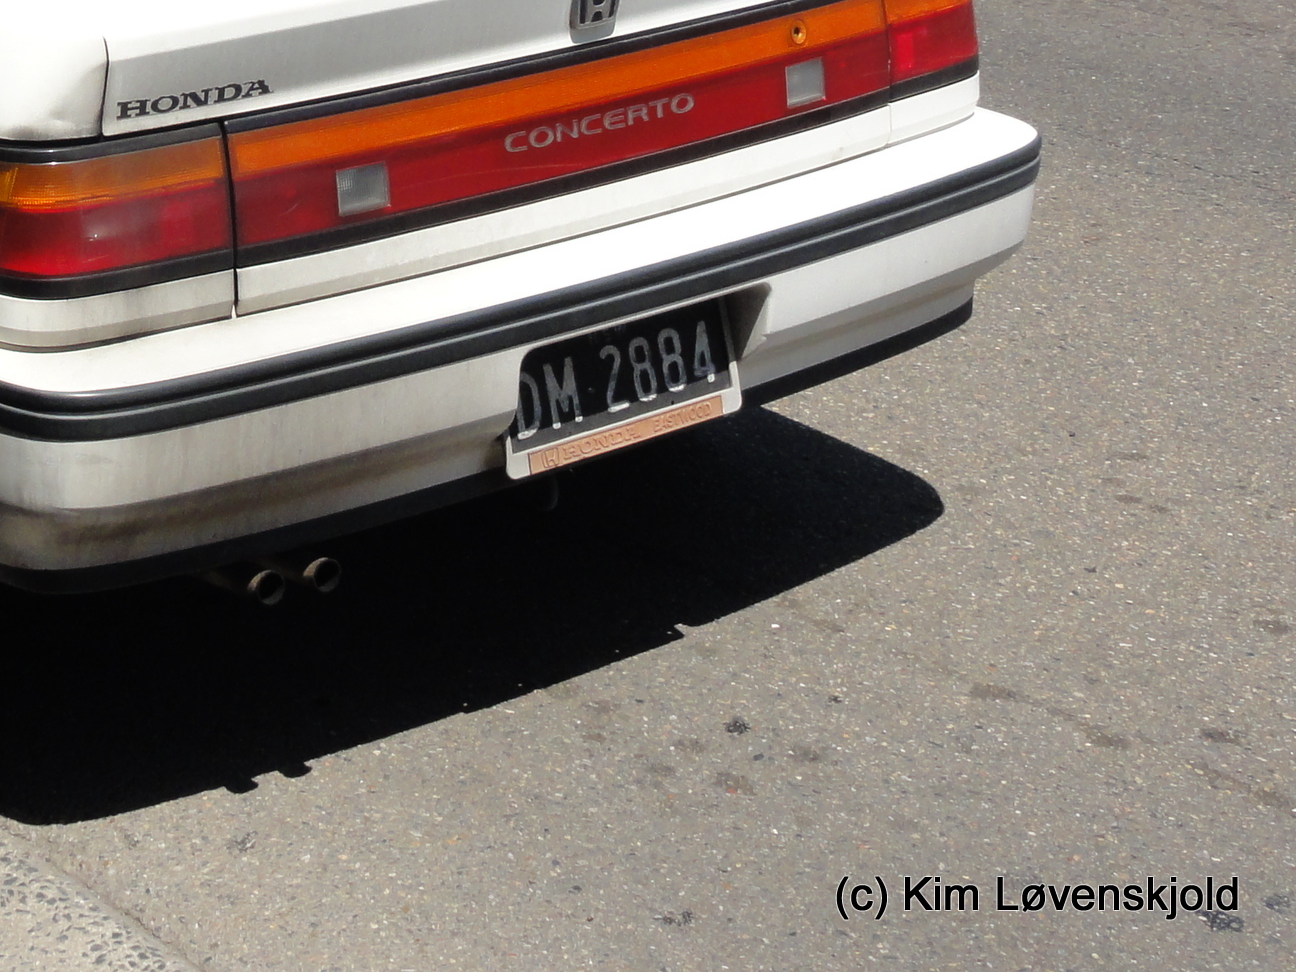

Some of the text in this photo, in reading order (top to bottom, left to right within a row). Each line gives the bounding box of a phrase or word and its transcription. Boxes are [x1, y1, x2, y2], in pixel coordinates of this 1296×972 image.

[116, 79, 274, 120] HONDA
[504, 92, 696, 154] CONCERTO
[515, 320, 717, 441] DM 2884
[563, 425, 642, 461] HONDA
